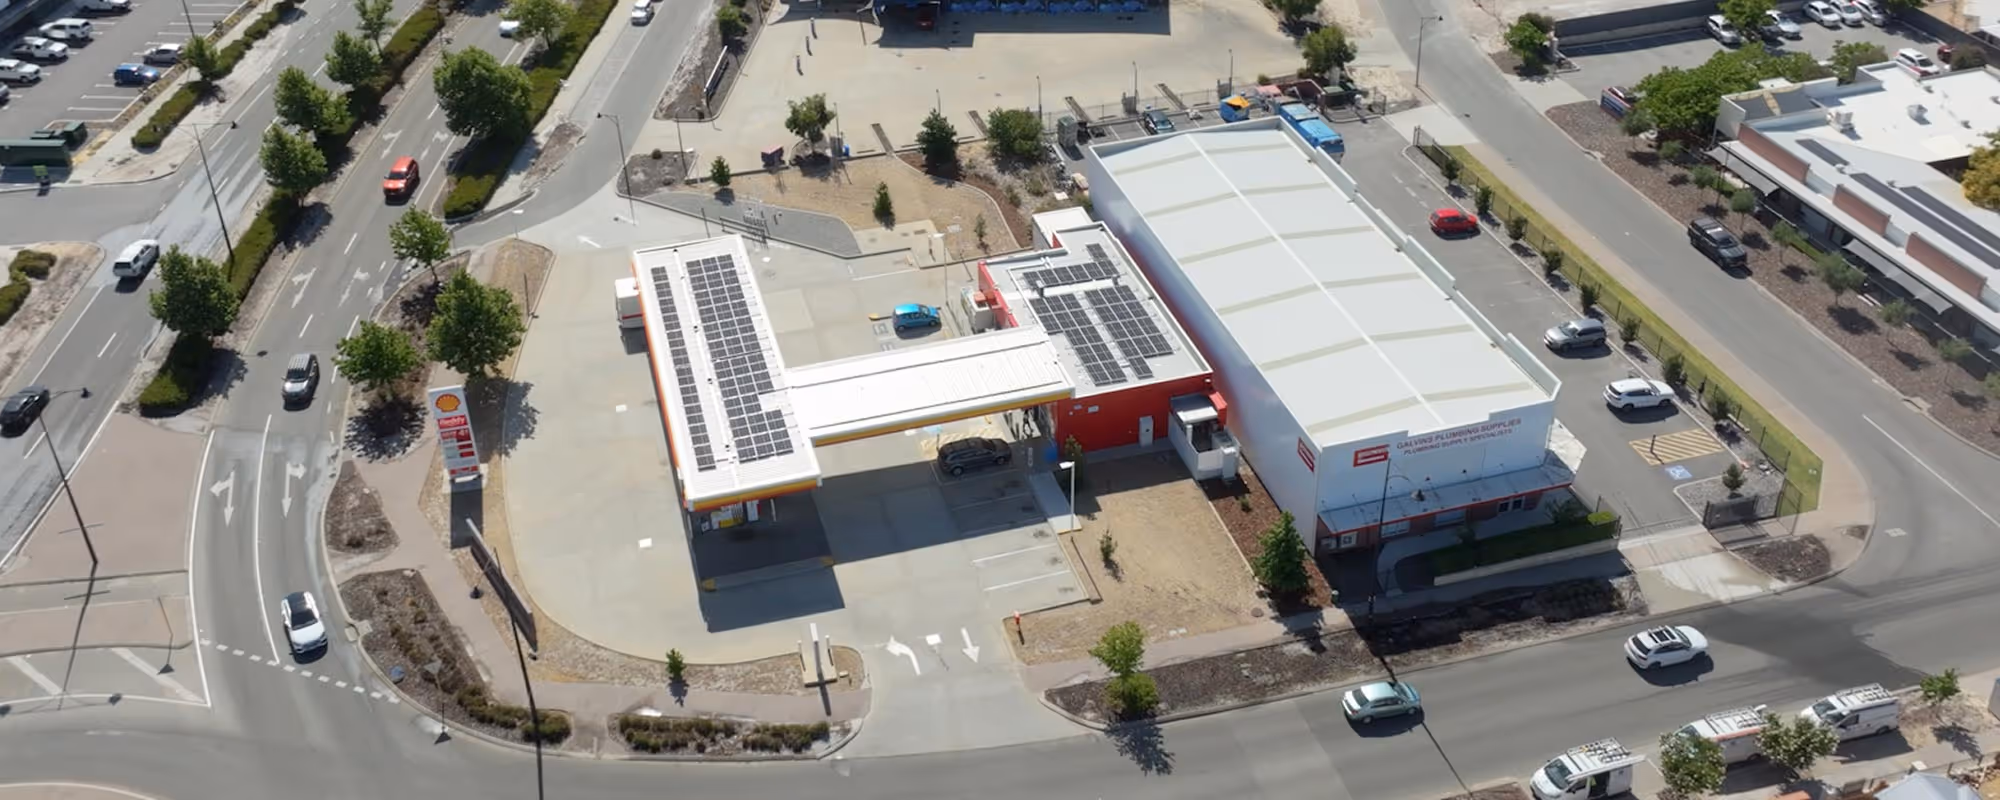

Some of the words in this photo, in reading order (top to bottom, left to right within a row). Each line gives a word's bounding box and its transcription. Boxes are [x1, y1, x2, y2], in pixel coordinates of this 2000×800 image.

[1397, 436, 1433, 449] GALVINS
[1435, 428, 1479, 441] PLUMBING
[1481, 418, 1521, 431] SUPPLIES
[1404, 443, 1440, 456] PLUMBING
[1442, 437, 1468, 448] SUPPLY
[1470, 429, 1512, 442] SPECIALISTS
